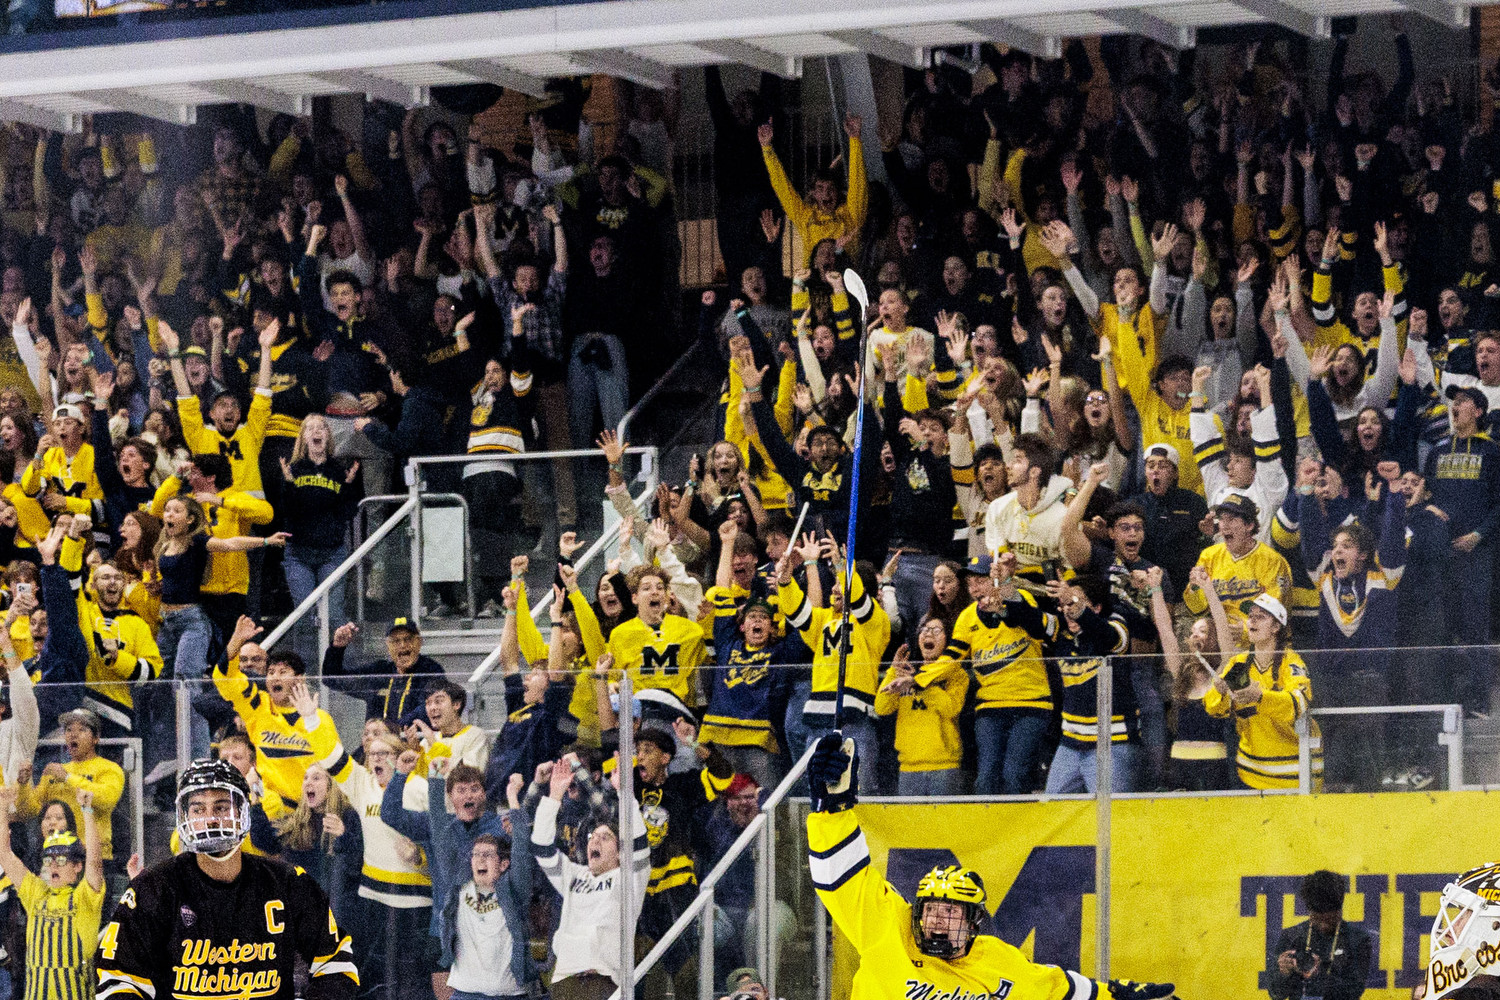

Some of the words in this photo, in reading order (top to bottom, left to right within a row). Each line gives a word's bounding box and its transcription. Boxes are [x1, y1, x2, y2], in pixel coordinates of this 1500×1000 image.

[640, 643, 680, 675] M
[911, 699, 927, 710] M
[261, 730, 311, 748] Michig
[264, 899, 285, 934] C
[1240, 873, 1464, 990] THE
[100, 921, 120, 960] 4
[182, 938, 277, 966] Western
